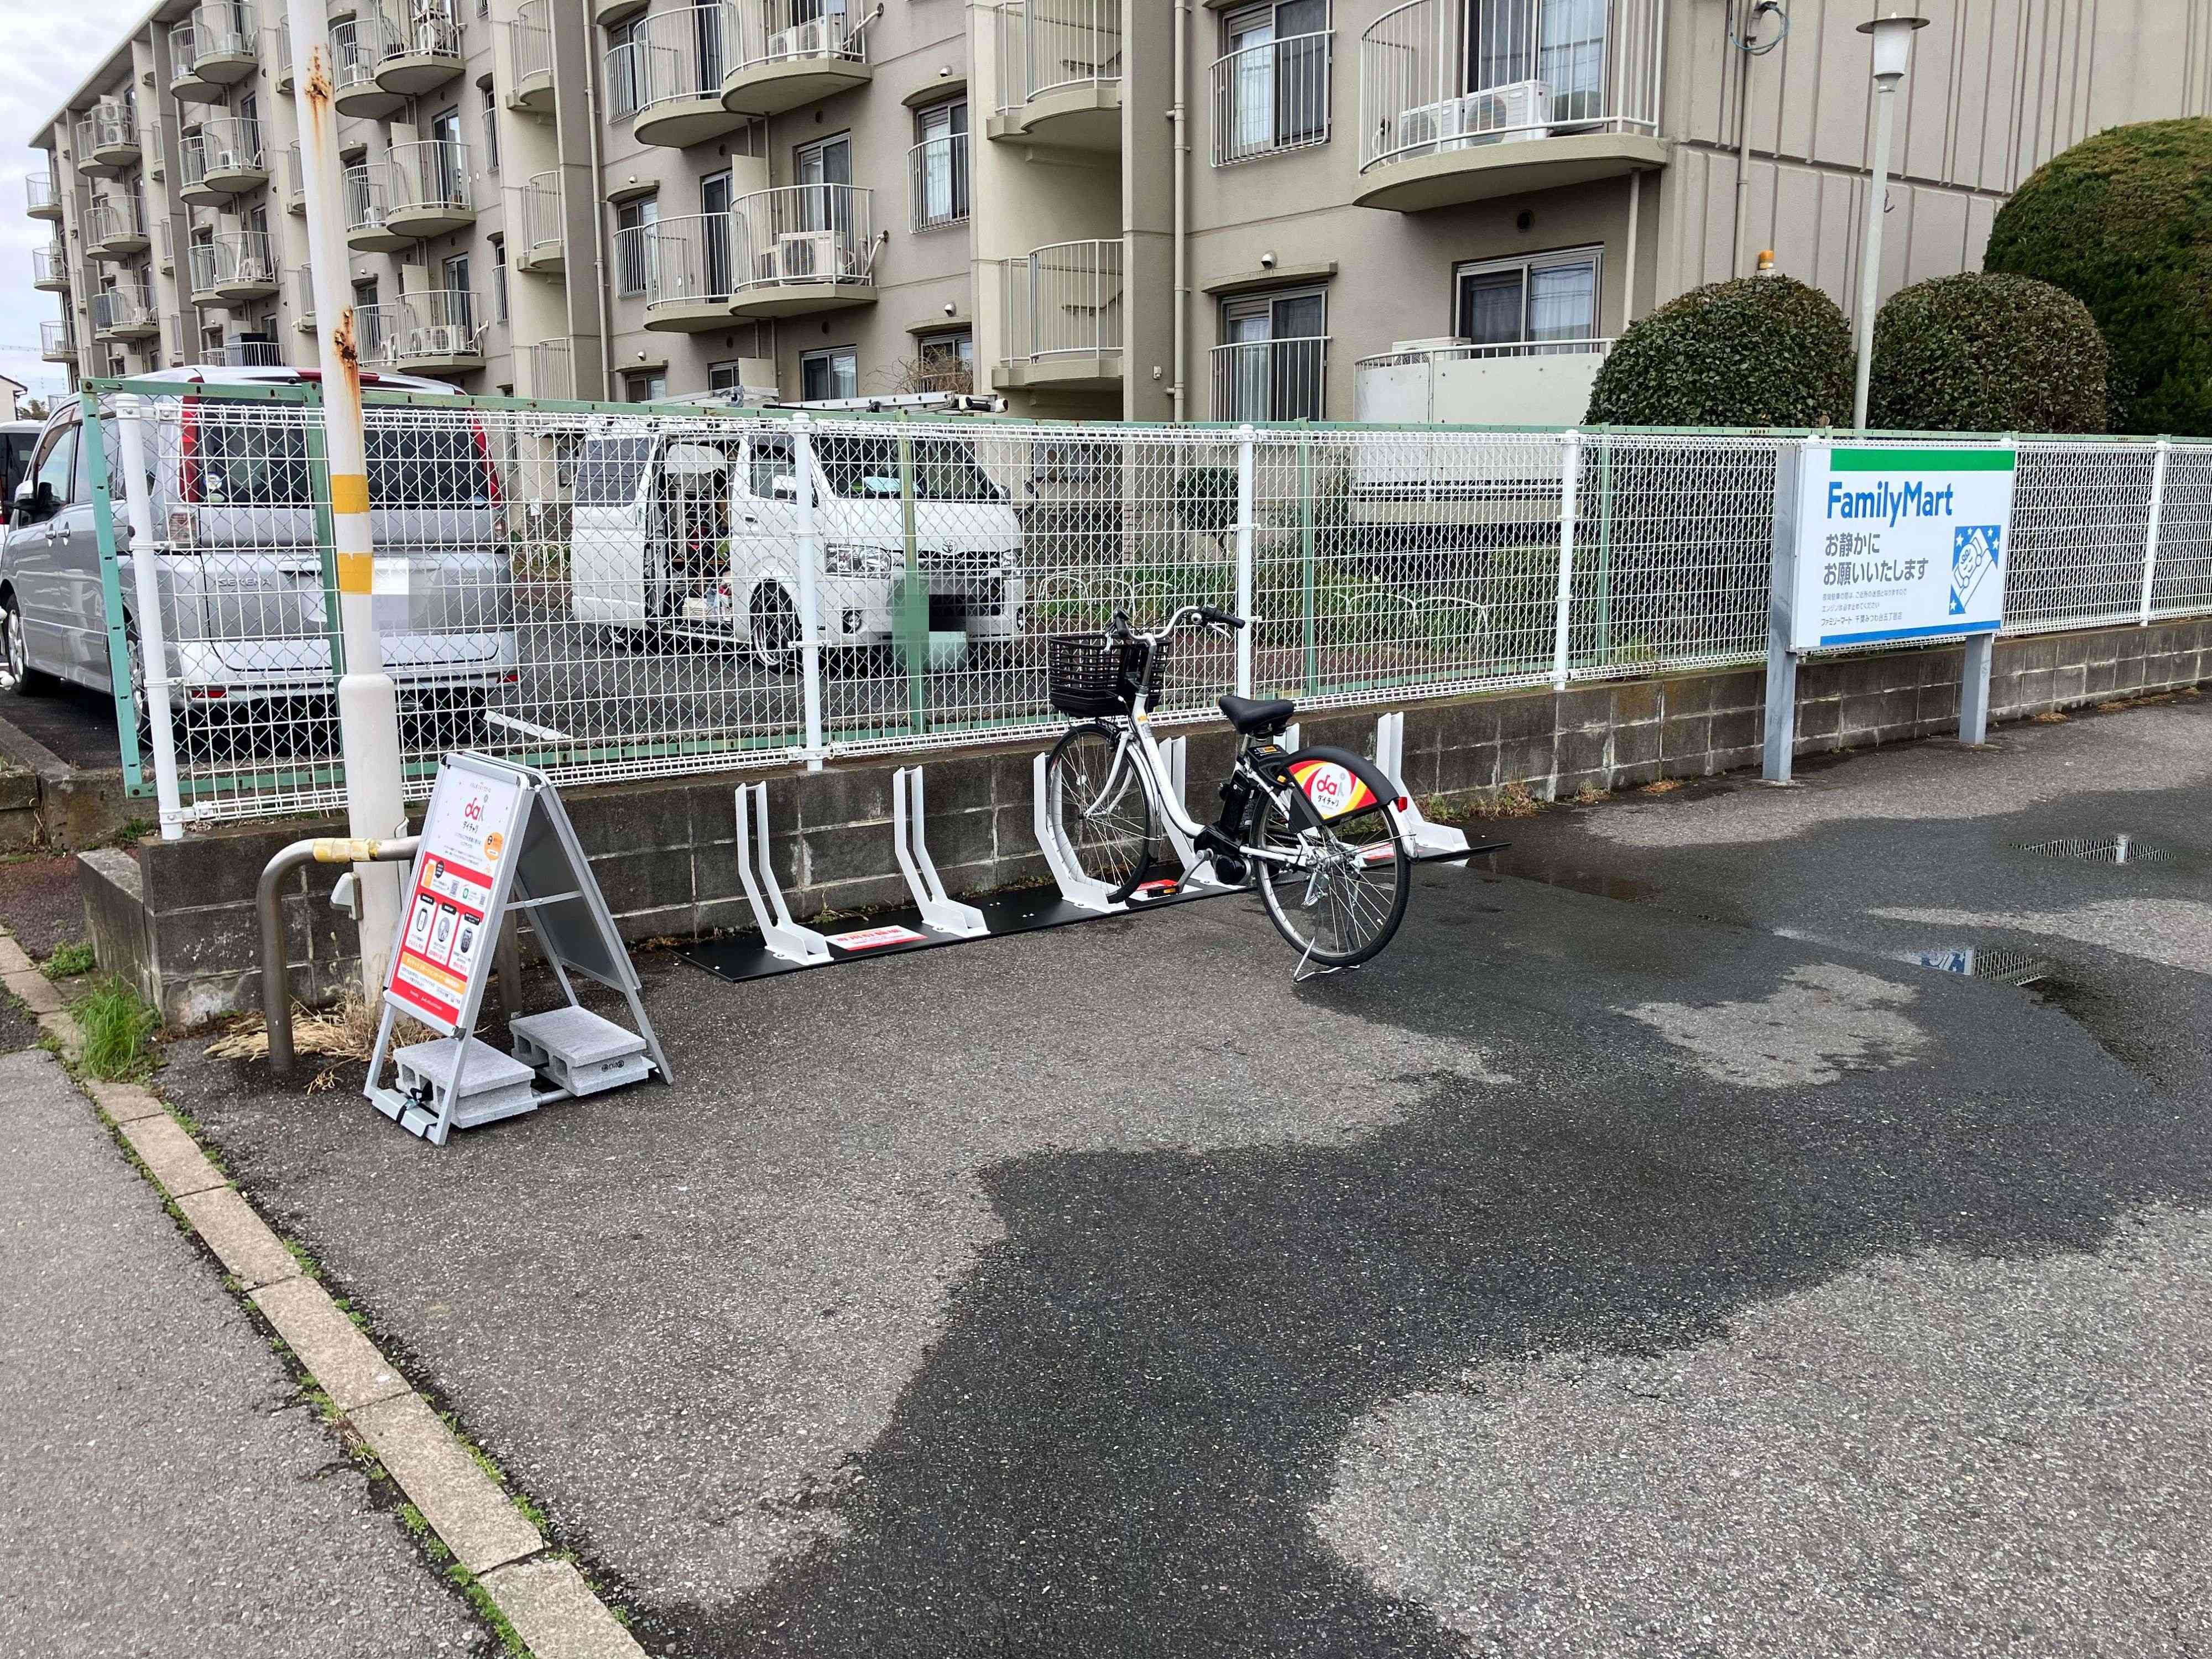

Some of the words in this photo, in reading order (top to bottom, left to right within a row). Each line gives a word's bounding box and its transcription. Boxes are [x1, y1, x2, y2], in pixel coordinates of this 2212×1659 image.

[1827, 481, 1954, 528] FamilyMart
[1825, 532, 1881, 557] お静かに
[1823, 557, 1929, 586] お願いいたします
[1822, 616, 1853, 626] ファミリーマート
[1318, 795, 1339, 807] ダイチャリ
